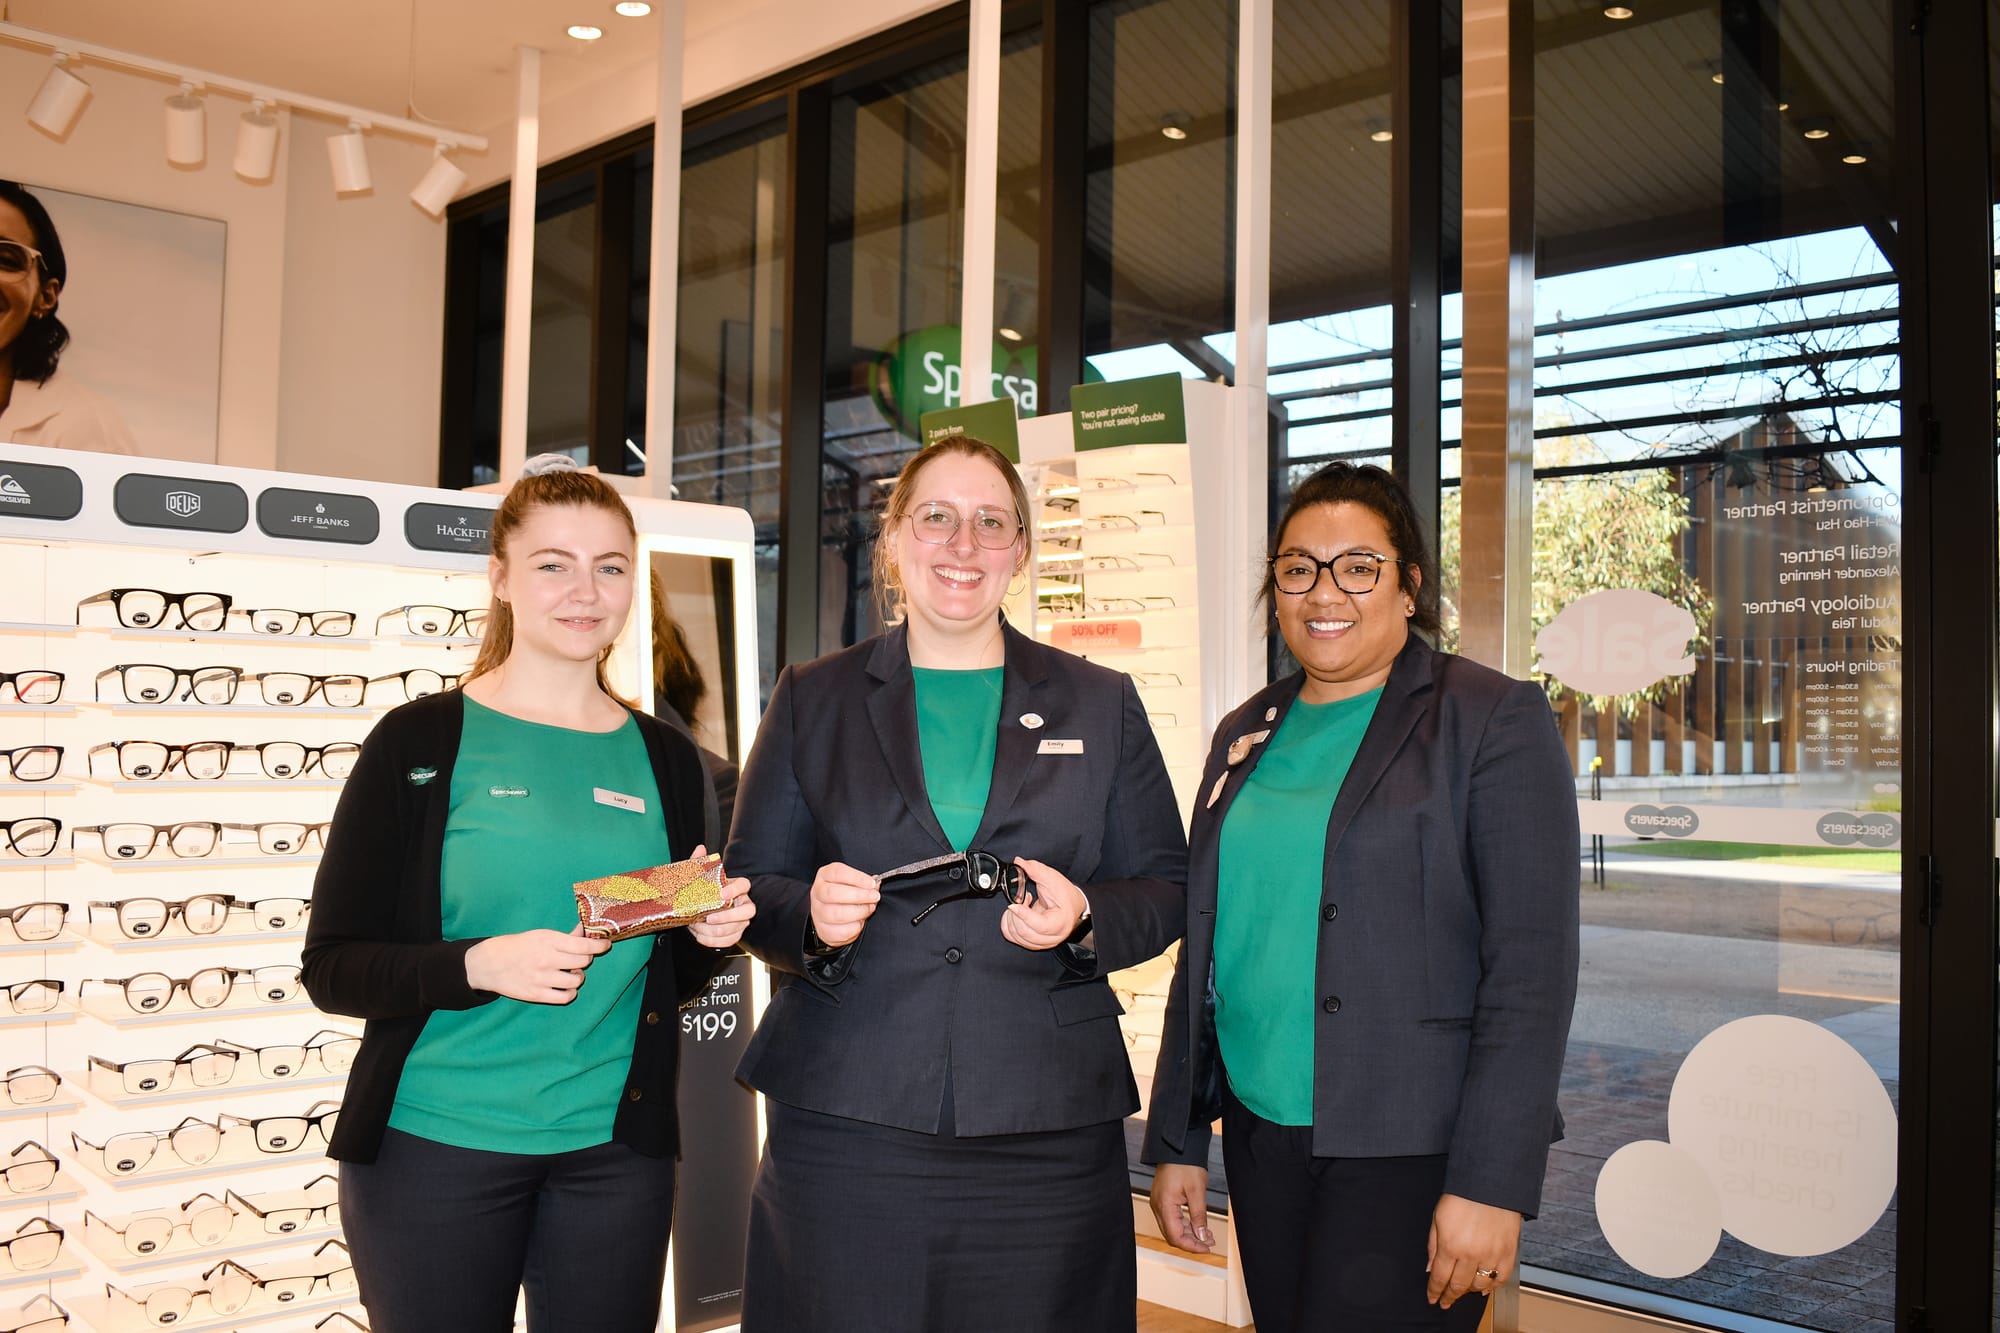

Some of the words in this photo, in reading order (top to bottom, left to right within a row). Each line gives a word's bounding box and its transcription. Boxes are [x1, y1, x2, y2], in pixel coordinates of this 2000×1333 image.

[1081, 410, 1095, 420] Two
[1096, 408, 1109, 419] pair
[1110, 403, 1138, 417] pricing?
[1082, 420, 1102, 430] You're
[1103, 419, 1115, 428] not
[1117, 416, 1139, 426] seeing
[1140, 412, 1165, 423] double
[291, 515, 315, 524] JEFF
[316, 517, 350, 527] BANKS
[436, 524, 488, 539] HACKETT
[1072, 624, 1094, 637] 50%
[1096, 623, 1118, 636] OFF
[710, 992, 740, 1006] from
[682, 1010, 737, 1042] $199
